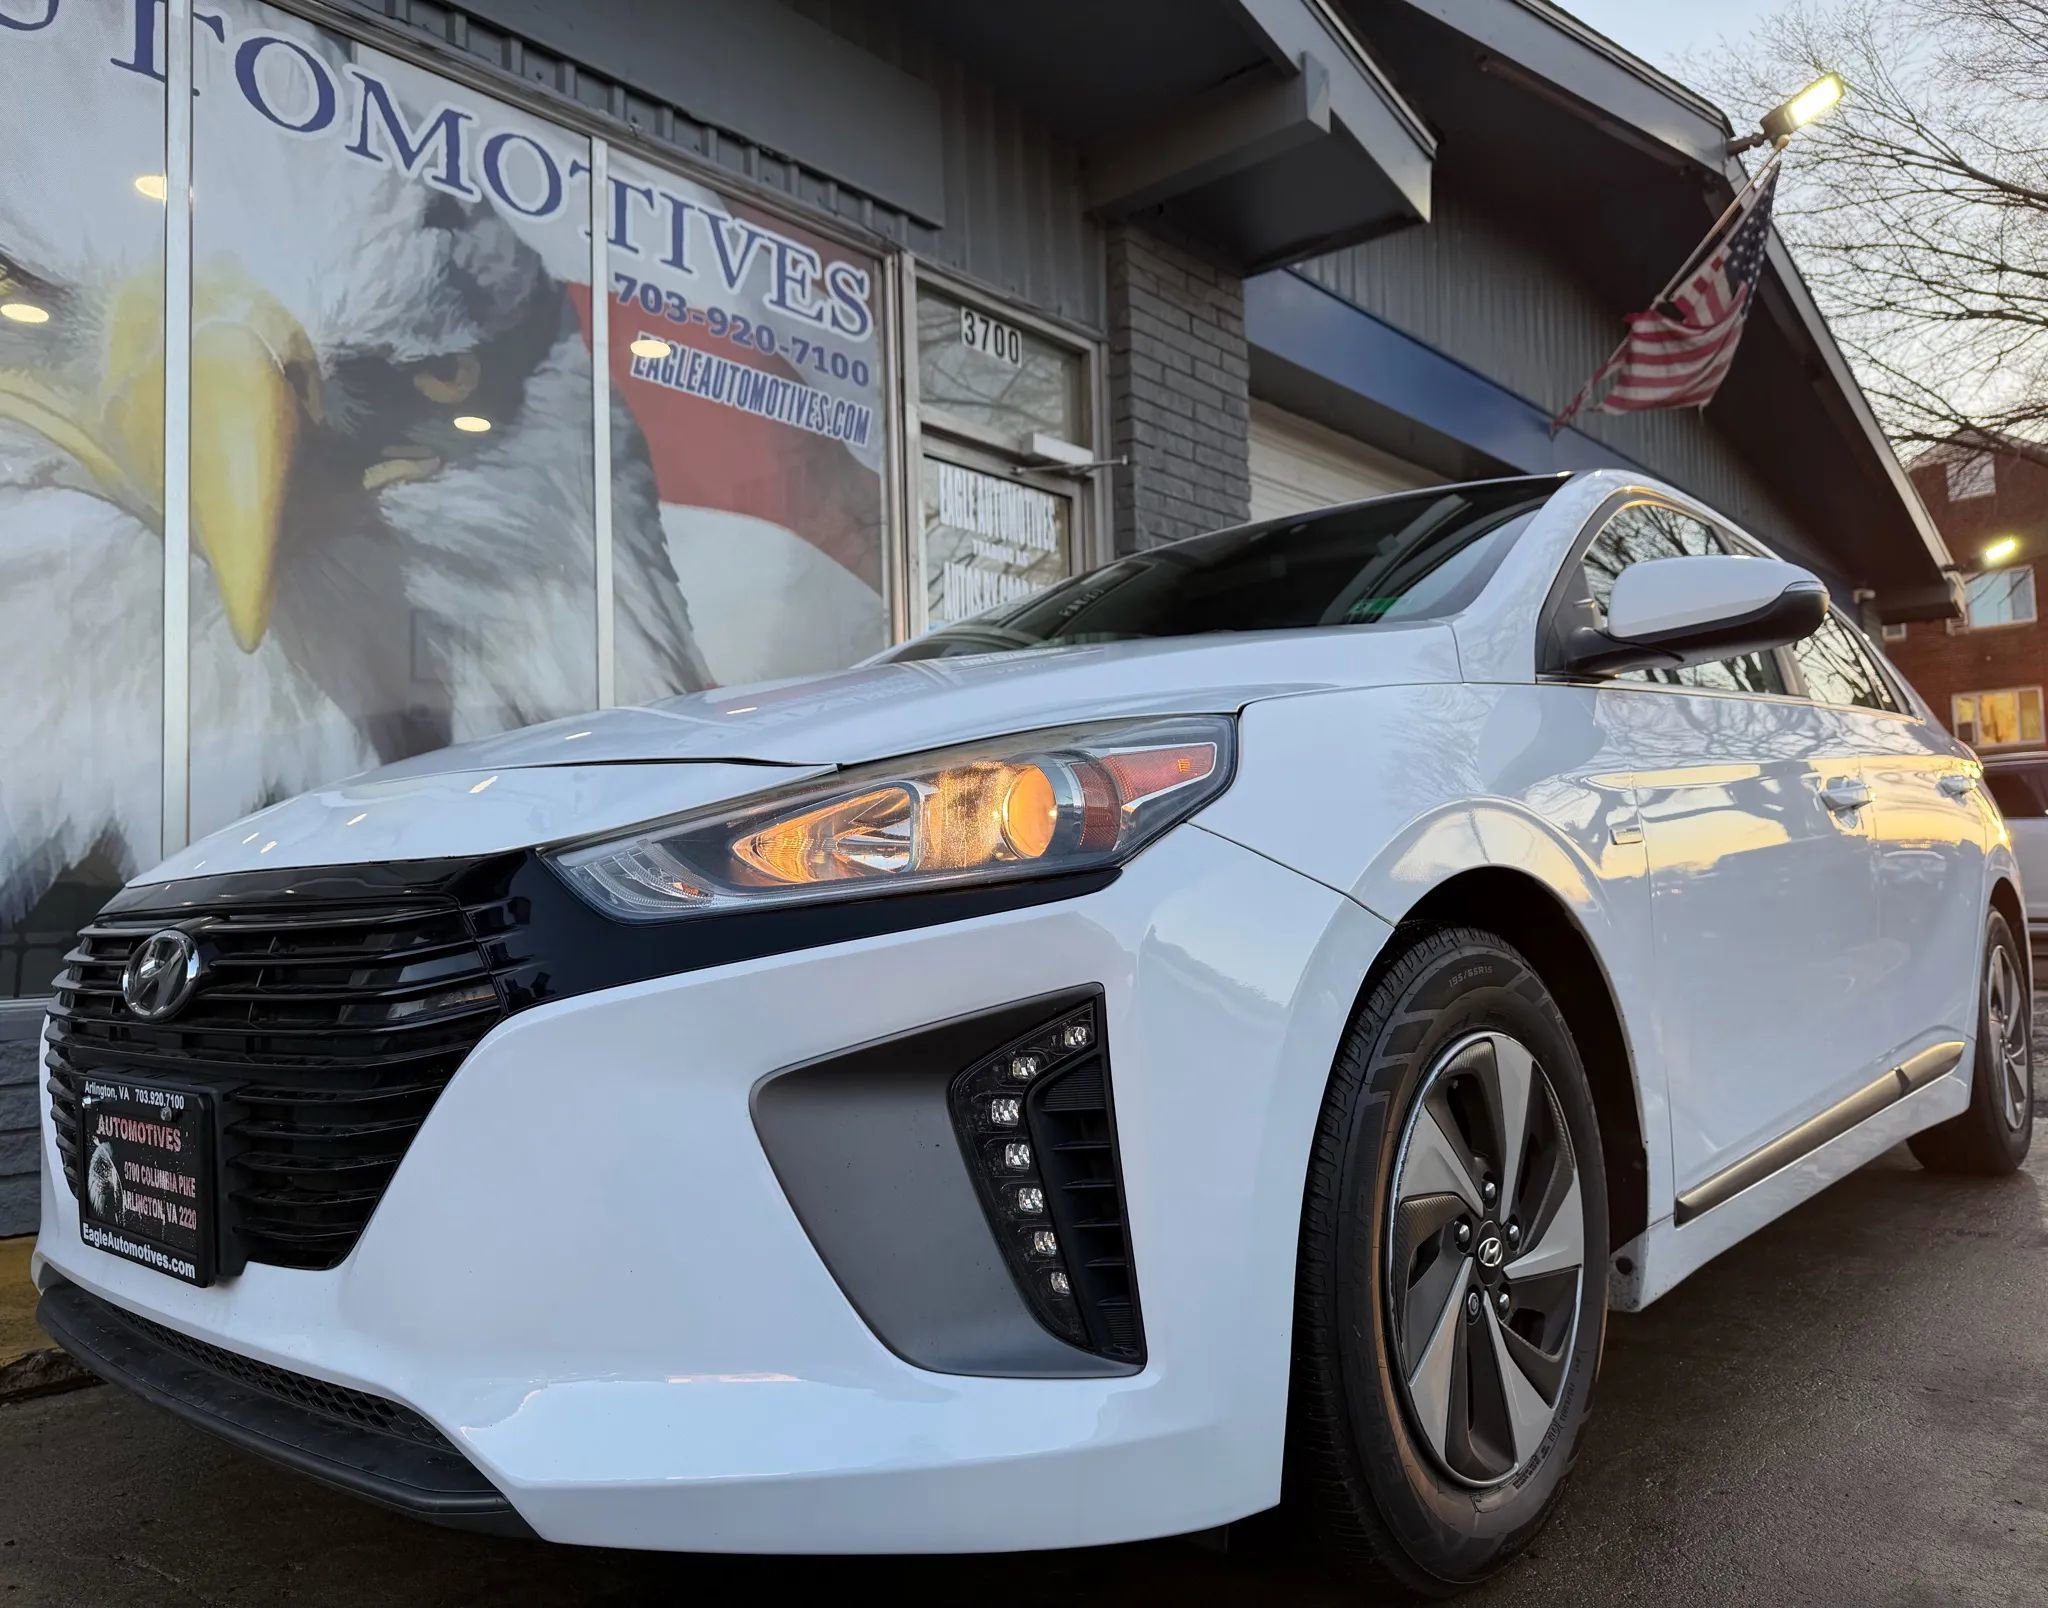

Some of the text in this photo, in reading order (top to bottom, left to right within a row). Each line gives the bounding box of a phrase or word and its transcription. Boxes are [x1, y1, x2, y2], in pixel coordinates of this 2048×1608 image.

[613, 272, 870, 387] 703-920-7100
[964, 311, 1019, 365] 3700
[633, 334, 872, 446] EAGLEAUTOMOTIVES.COM
[84, 1080, 185, 1110] Arlington, VA 703.920.7100
[96, 1114, 182, 1152] AUTOMOTIVES
[141, 1164, 178, 1194] COLUMBIA
[178, 1174, 196, 1199] PIKE
[166, 1201, 178, 1225] VA
[82, 1222, 196, 1280] EagleAutomotives.com
